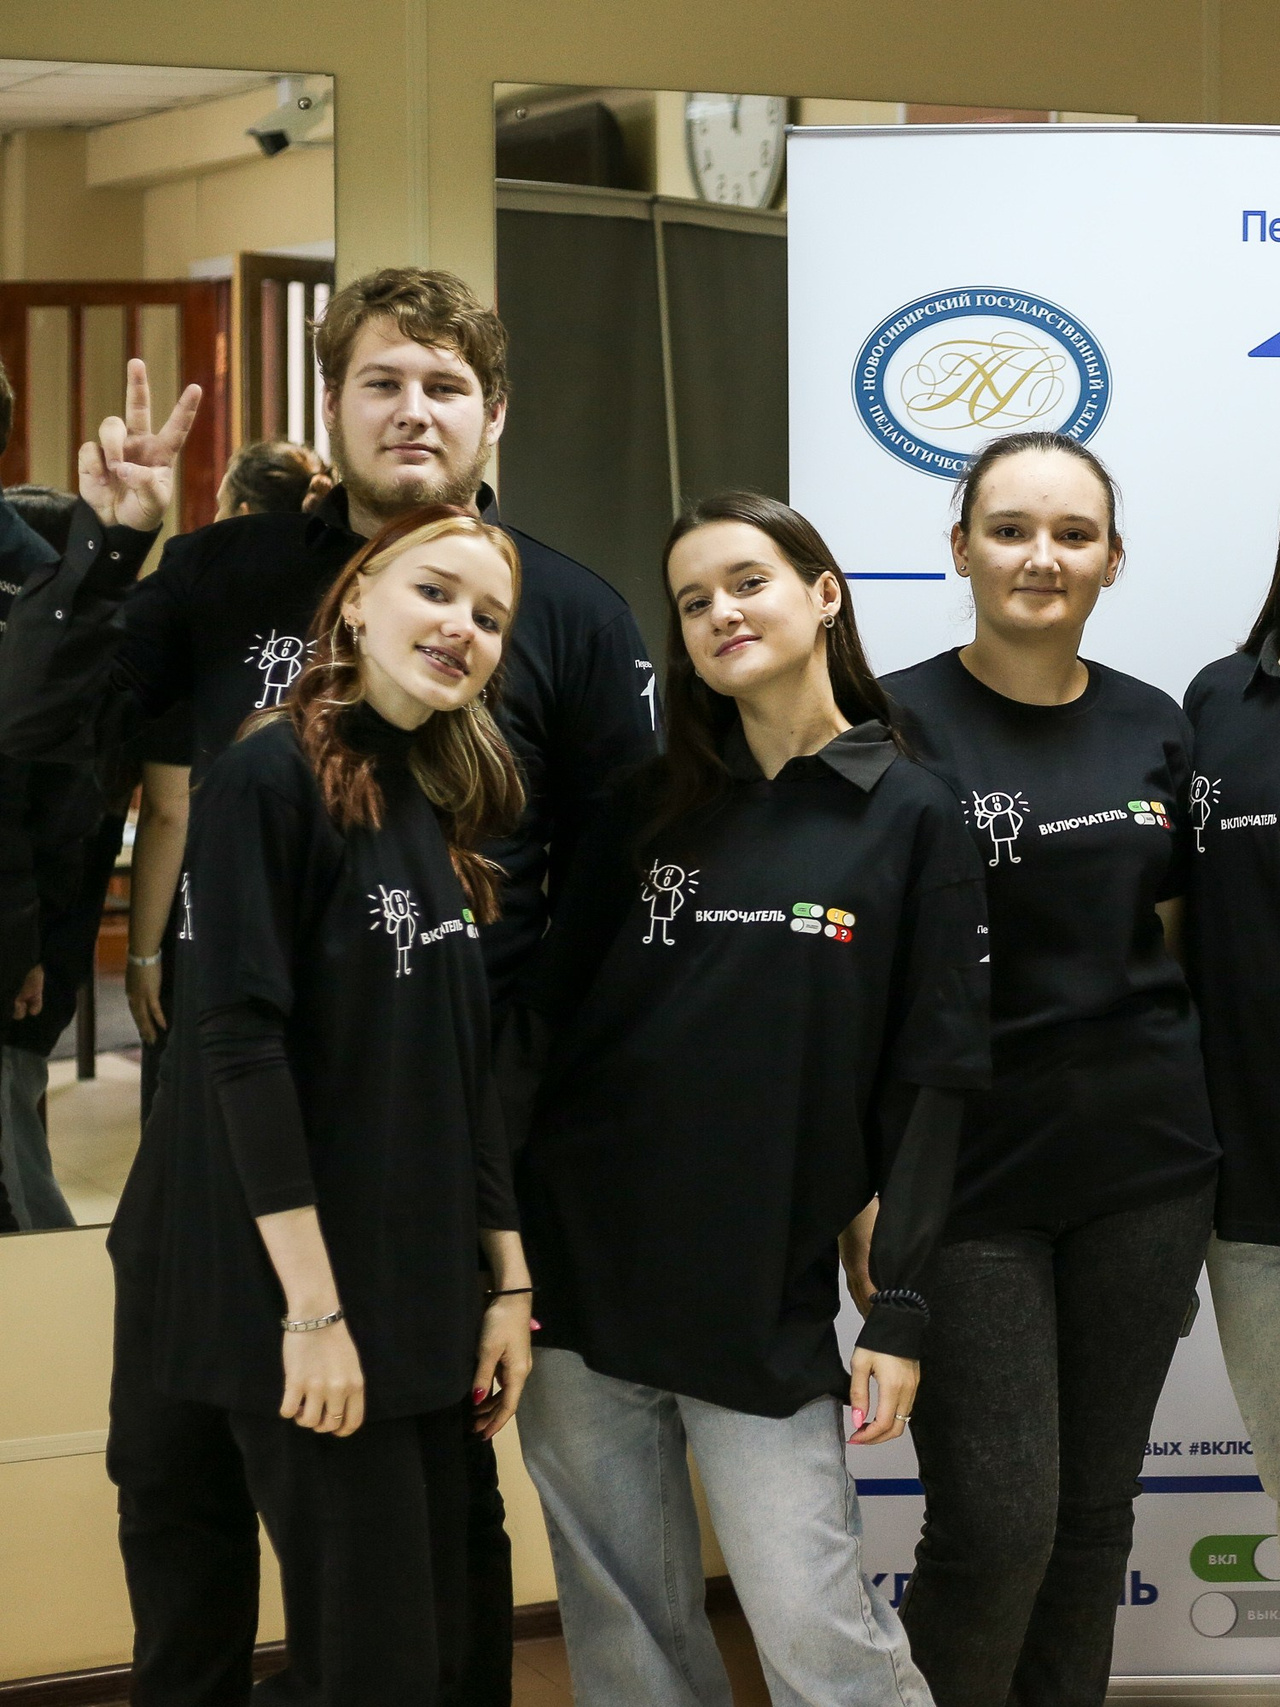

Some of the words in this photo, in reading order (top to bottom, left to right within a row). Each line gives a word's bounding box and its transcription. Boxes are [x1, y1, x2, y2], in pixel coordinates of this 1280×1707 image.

[862, 292, 972, 391] НОВОСИБИРСКИЙ
[975, 293, 1105, 391] ГОСУДАРСТВЕННЫЙ
[868, 403, 972, 472] ПЕДАГОГИЧЕС
[1038, 809, 1128, 836] ВКЛЮЧАТЕЛЬ
[1220, 813, 1278, 831] ВКЛЮЧАТЕЛЬ
[695, 909, 787, 923] ВКЛЮЧАТЕЛЬ
[1208, 1553, 1238, 1565] ВКЛ
